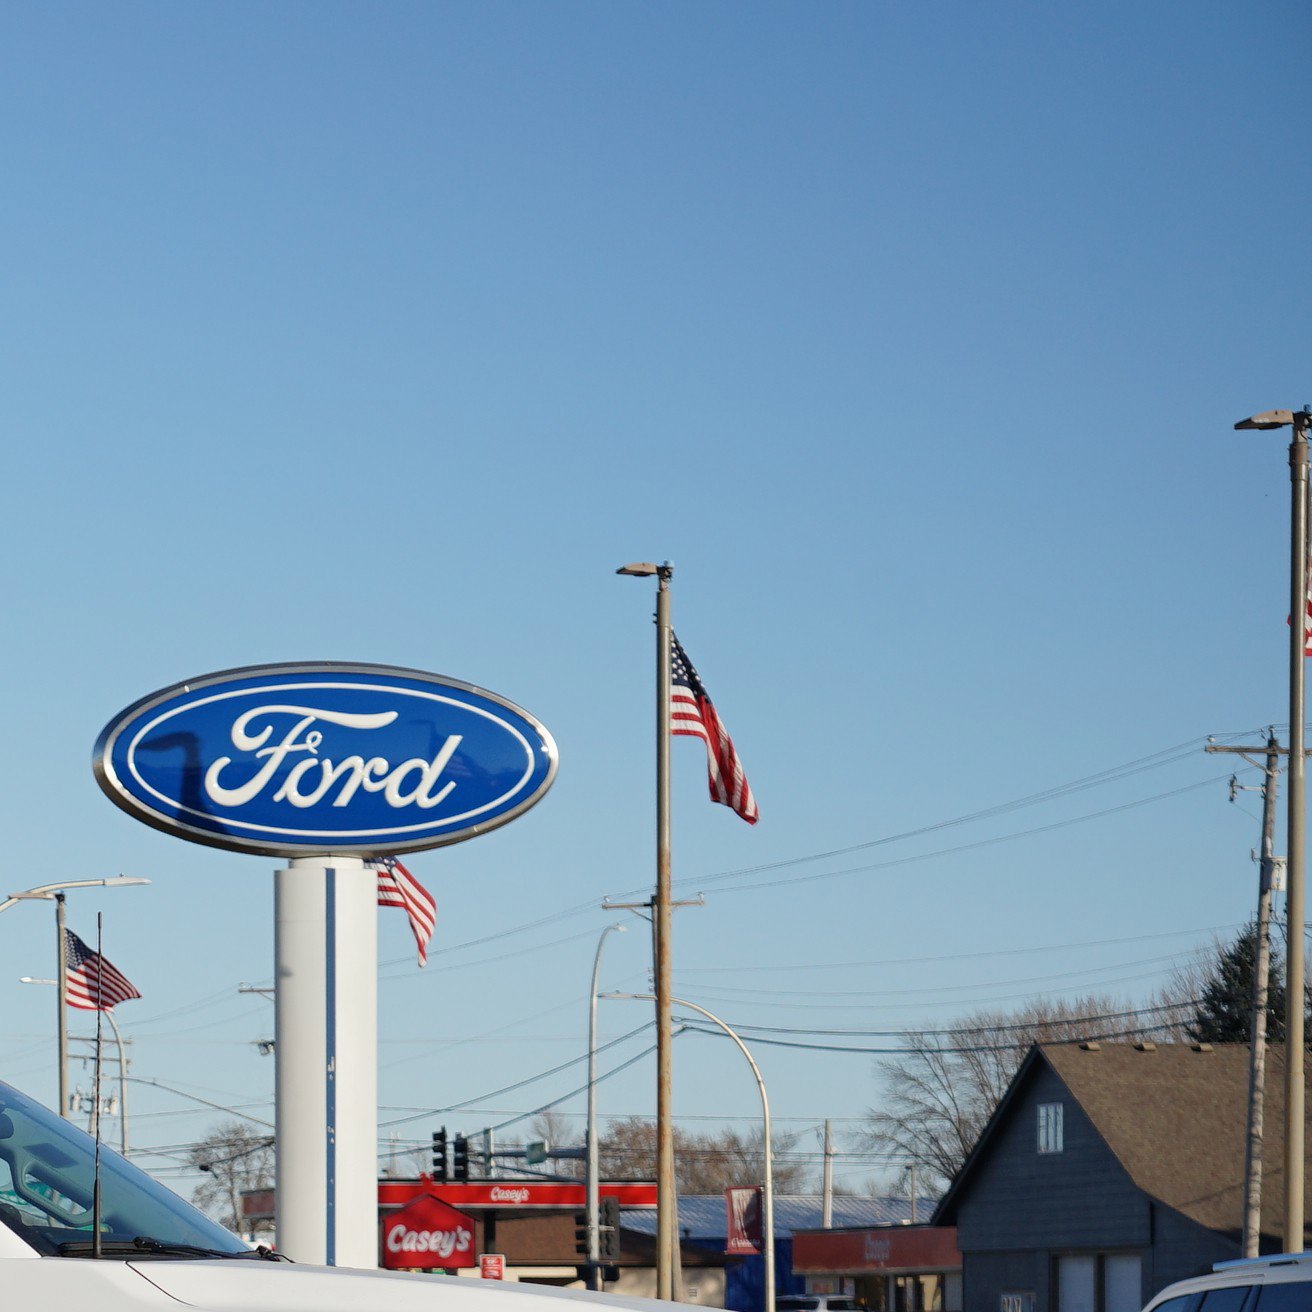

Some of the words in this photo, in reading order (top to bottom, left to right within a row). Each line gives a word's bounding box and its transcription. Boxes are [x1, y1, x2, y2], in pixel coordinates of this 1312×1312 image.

[205, 705, 463, 808] Ford
[490, 1187, 530, 1203] Casey's
[387, 1224, 472, 1258] Casey's
